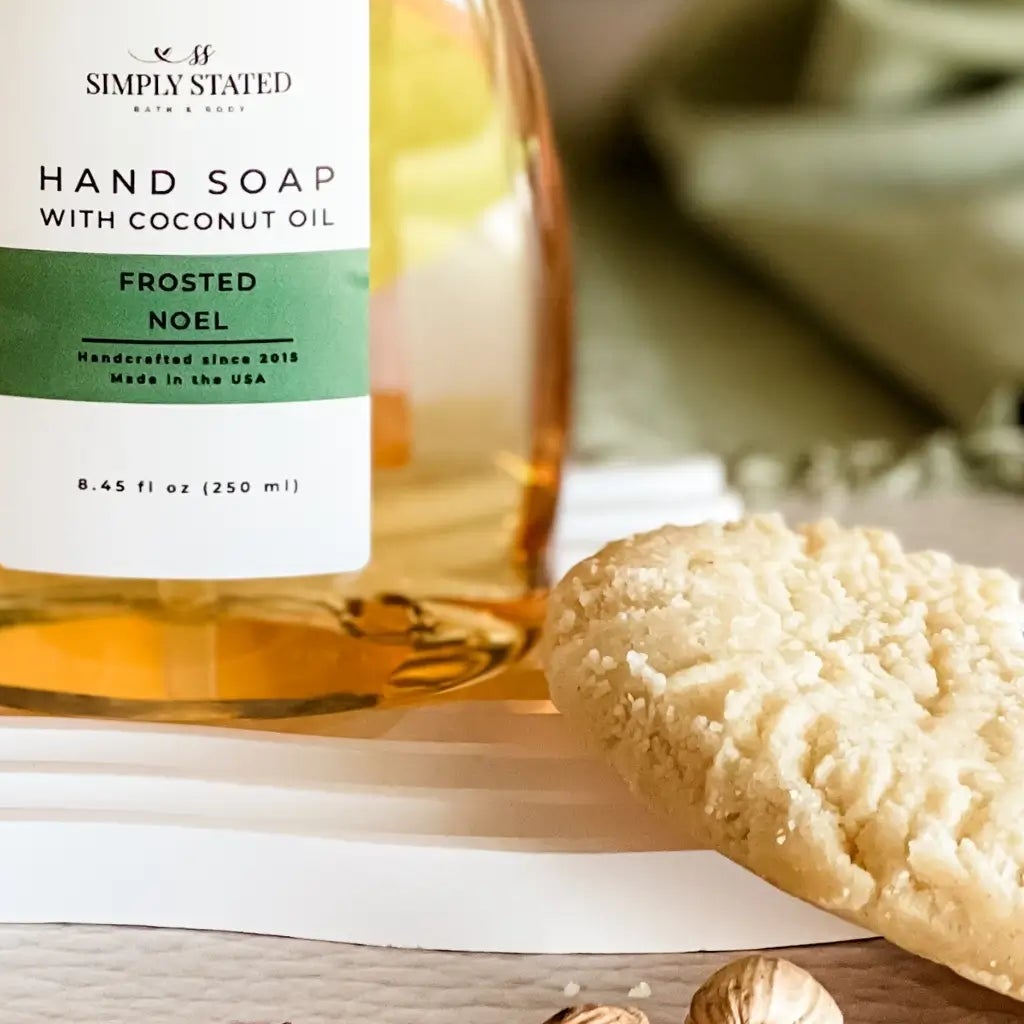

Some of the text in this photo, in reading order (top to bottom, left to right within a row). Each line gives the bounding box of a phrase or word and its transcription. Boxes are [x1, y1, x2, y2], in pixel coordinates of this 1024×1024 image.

[86, 71, 292, 96] SIMPLY STATED
[133, 105, 173, 113] BATH
[205, 105, 245, 113] BODY
[40, 165, 335, 196] HAND SOAP
[39, 207, 335, 231] WITH COCONUT OIL
[119, 271, 257, 293] FROSTED
[149, 310, 229, 331] NOEL
[77, 350, 193, 366] Handcrafted
[201, 353, 251, 366] since
[110, 372, 266, 386] Made in the USA
[77, 478, 298, 497] 8.45 fl oz (250 ml)
